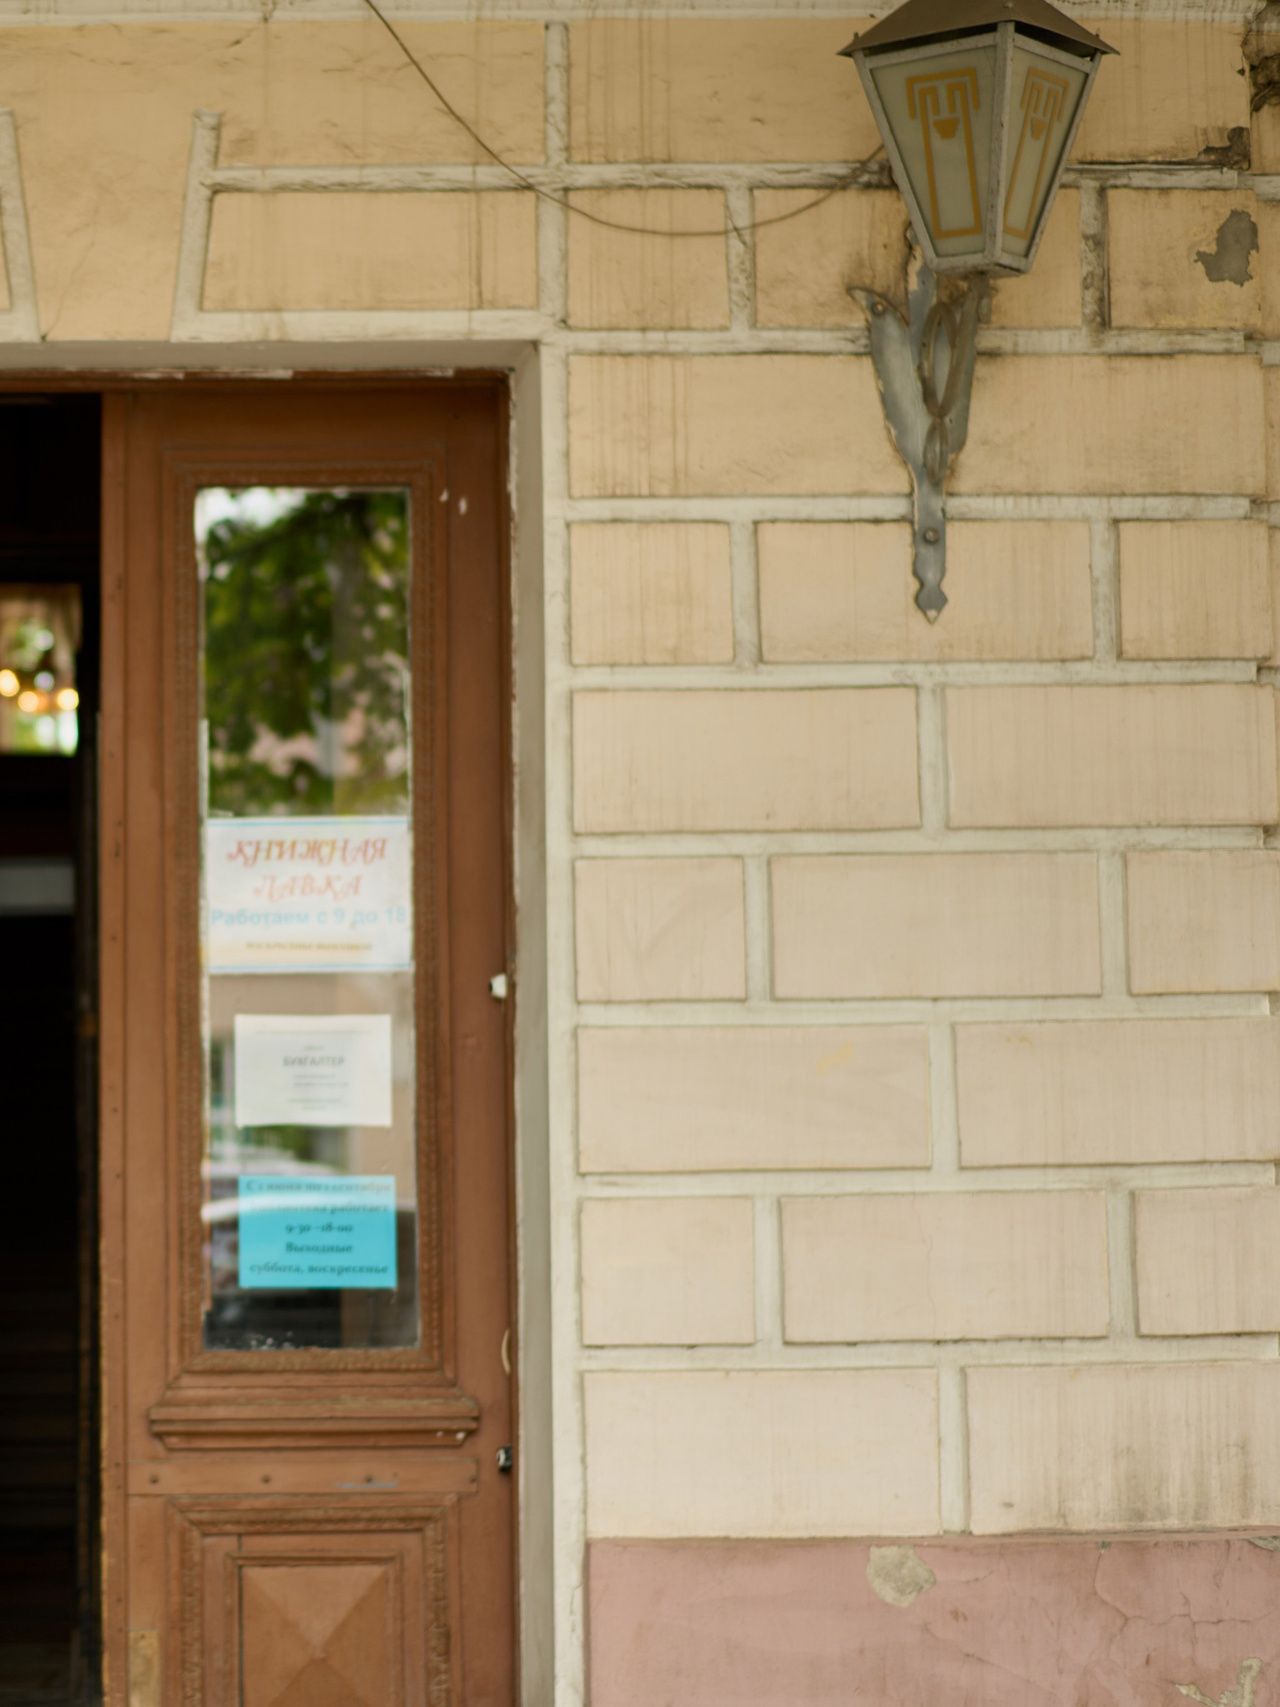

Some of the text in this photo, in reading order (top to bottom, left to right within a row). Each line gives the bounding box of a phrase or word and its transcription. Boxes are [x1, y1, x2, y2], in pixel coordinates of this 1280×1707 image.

[225, 837, 388, 867] КНИЖНАЯ
[252, 873, 363, 903] ЛАВКА
[211, 905, 407, 929] Работаем с 9 до 18
[282, 1055, 345, 1067] БУХГАЛТЕР
[285, 1241, 354, 1253] Выходные
[249, 1261, 389, 1276] суббота, воскресенье
